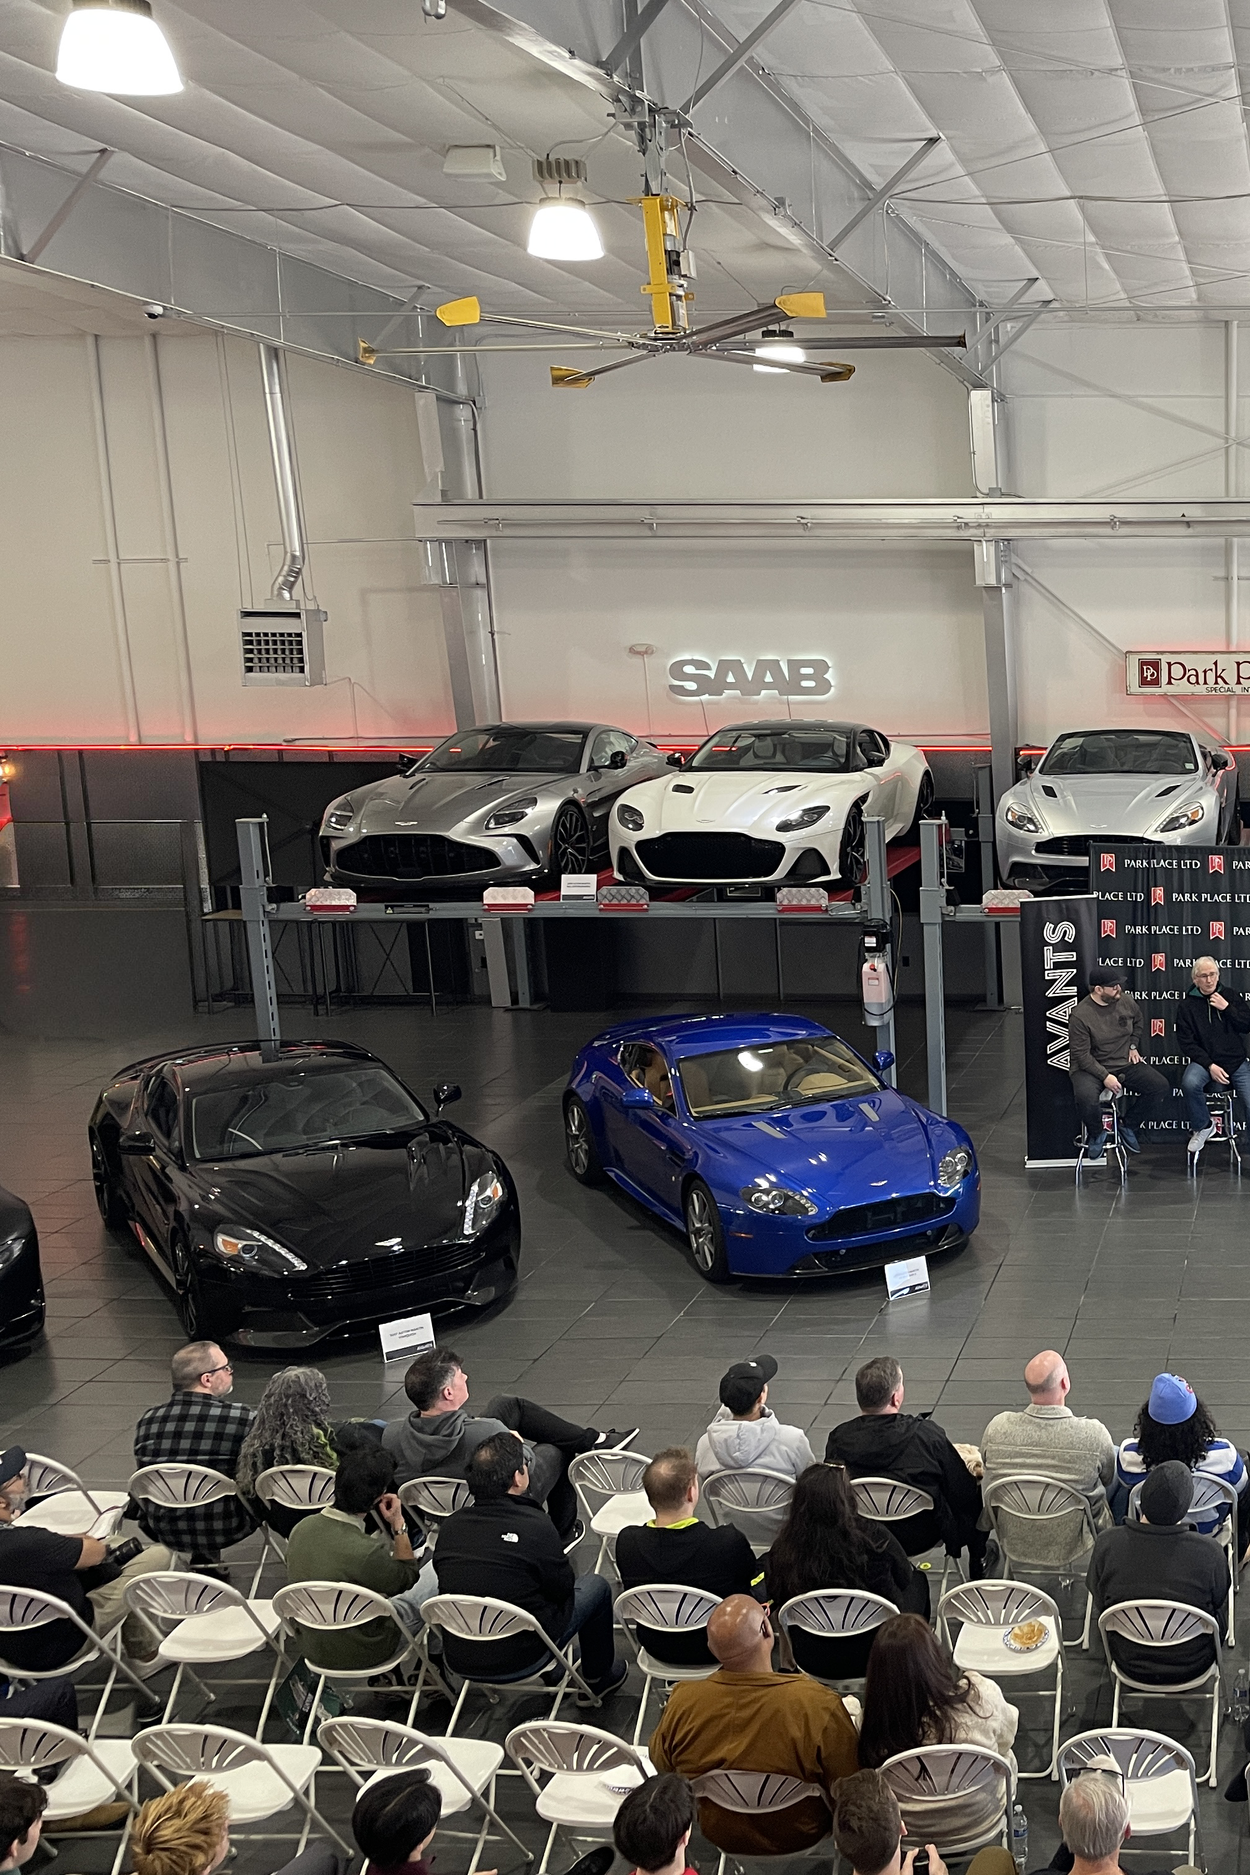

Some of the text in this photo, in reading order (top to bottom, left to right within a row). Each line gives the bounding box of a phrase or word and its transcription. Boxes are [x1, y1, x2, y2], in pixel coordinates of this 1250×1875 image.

[668, 658, 832, 697] SAAB
[1165, 660, 1234, 686] Park
[1205, 686, 1236, 694] SPECIAL
[1124, 859, 1149, 868] PARK
[1180, 860, 1201, 869] LTD
[1127, 892, 1145, 902] LTD
[1172, 893, 1199, 902] PARK
[1201, 893, 1232, 903] PLACE
[1125, 925, 1150, 934] PARK
[1151, 925, 1180, 935] PLACE
[1182, 926, 1202, 935] LTD
[1097, 957, 1145, 967] LACE LTD
[1043, 921, 1078, 1071] AVANTS
[1151, 991, 1180, 1000] PLACE
[1150, 1056, 1179, 1065] PLACE
[1148, 1121, 1178, 1130] PLACE
